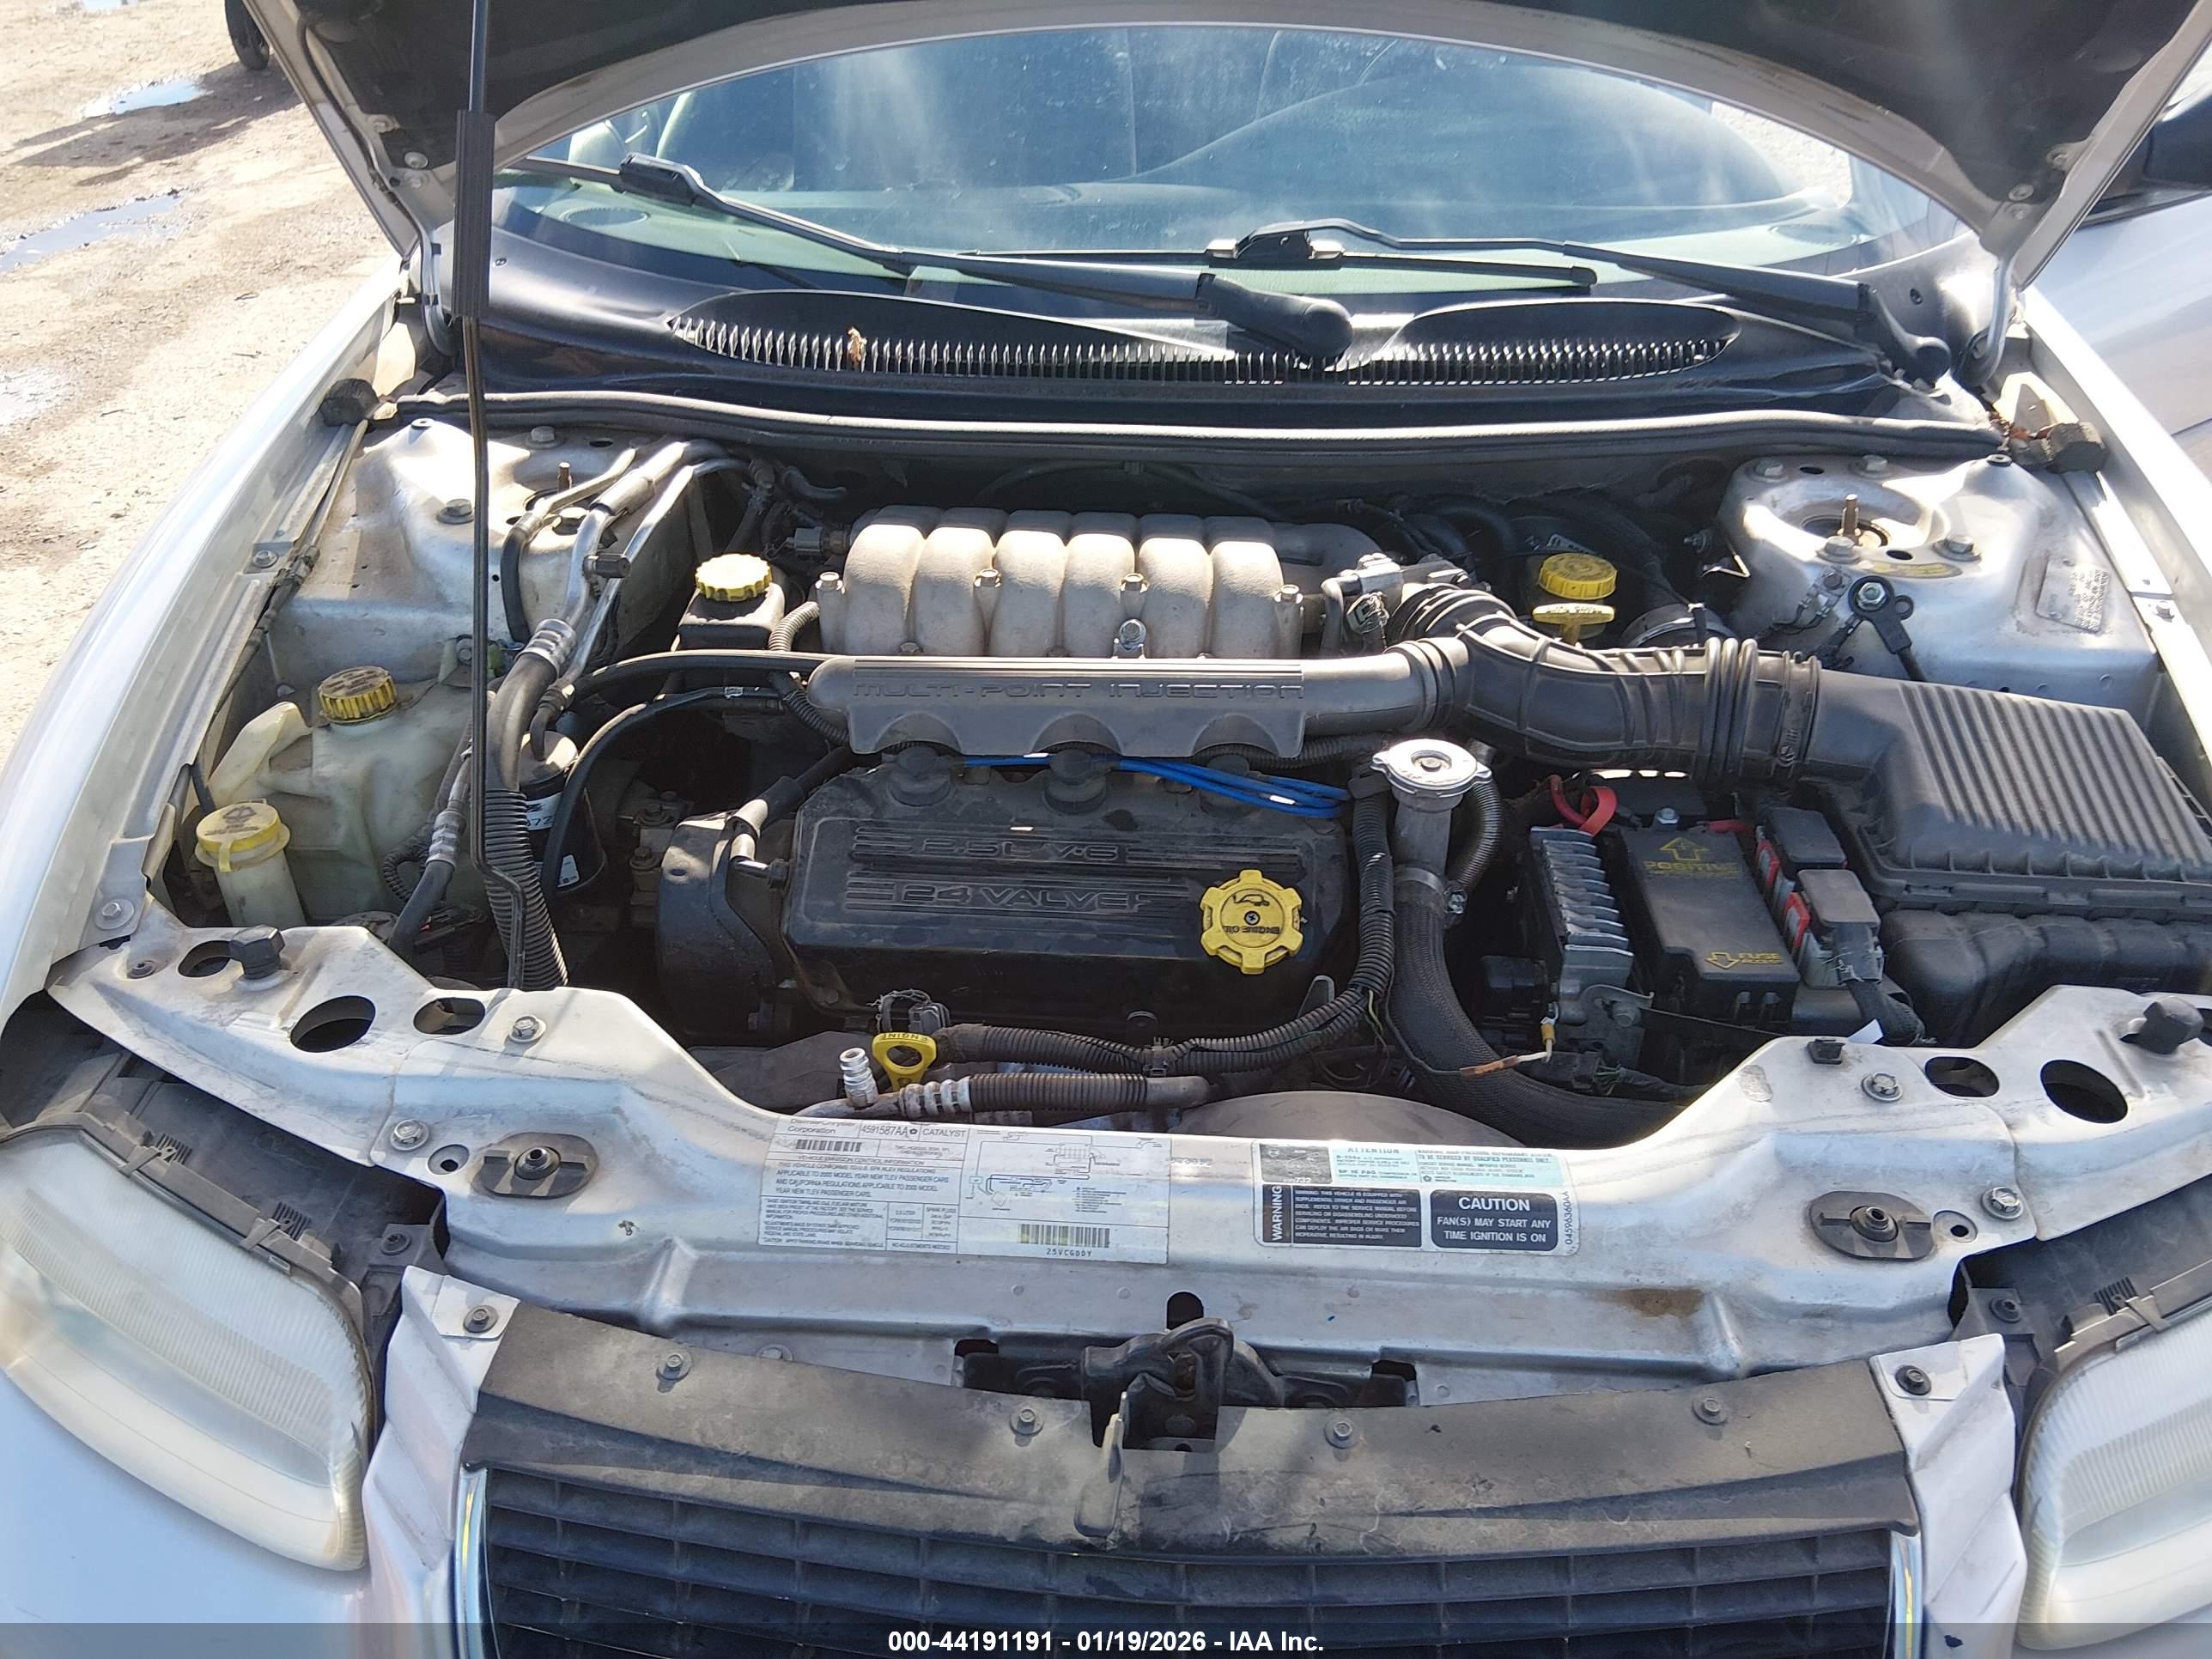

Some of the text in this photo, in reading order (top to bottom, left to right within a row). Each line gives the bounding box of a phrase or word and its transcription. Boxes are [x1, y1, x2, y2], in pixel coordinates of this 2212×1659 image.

[854, 684, 1304, 699] MULTI-POINT INJECTION
[921, 837, 1034, 858] 2.5L
[902, 884, 1138, 912] 24 VALVE
[1222, 926, 1279, 934] ENGINE OIL
[787, 1126, 836, 1134] Corporation
[861, 1125, 908, 1136] 4591587AA
[922, 1127, 967, 1137] CATALYST
[1459, 1197, 1530, 1212] CAUTION
[1271, 1185, 1283, 1241] WARNING
[1437, 1216, 1552, 1229] FAN(S) MAY START ANY
[1443, 1231, 1547, 1243] TIME IGNITION IS ON
